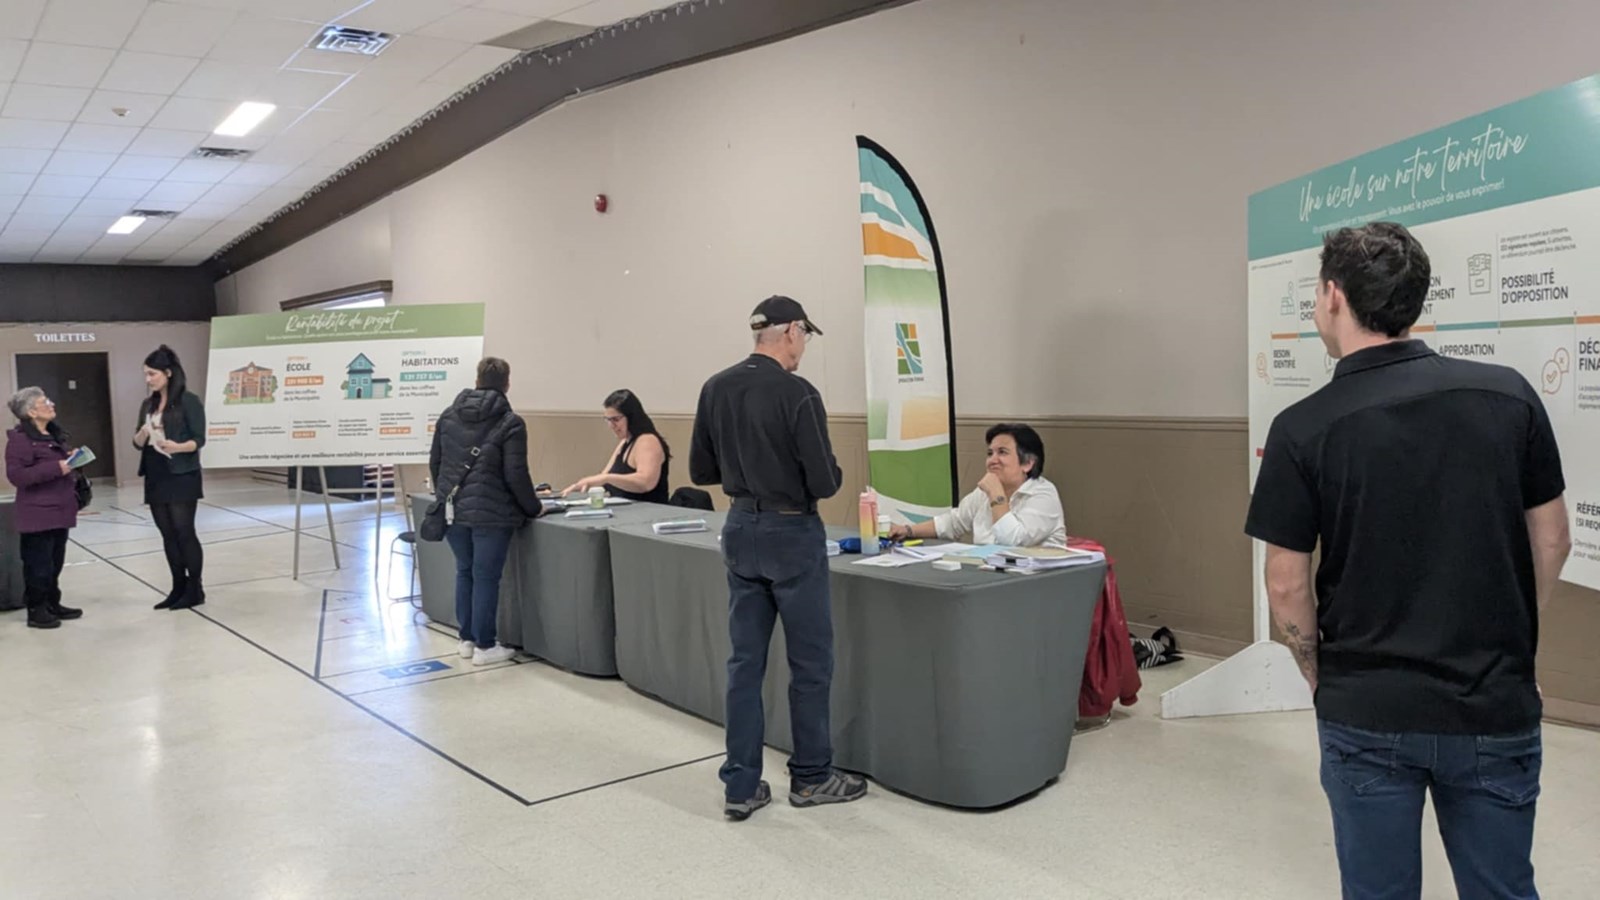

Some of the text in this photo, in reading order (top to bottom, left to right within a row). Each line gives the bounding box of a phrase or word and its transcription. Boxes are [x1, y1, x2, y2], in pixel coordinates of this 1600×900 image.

[1300, 181, 1323, 221] Une
[1326, 166, 1364, 208] école
[1367, 176, 1392, 201] sur
[1395, 147, 1438, 198] notre
[1433, 123, 1527, 191] territoire
[1501, 267, 1555, 289] POSSIBILITÉ
[1501, 285, 1569, 304] D'OPPOSITION
[285, 309, 404, 333] Rentabilité du projet
[34, 333, 96, 342] TOILETTES
[1273, 349, 1291, 359] BESOIN
[1439, 343, 1495, 356] APPROBATION
[401, 357, 459, 366] HABITATIONS
[410, 390, 440, 398] Municipalité
[250, 452, 270, 460] entente
[311, 451, 336, 459] meilleure
[336, 450, 364, 458] rentabilité
